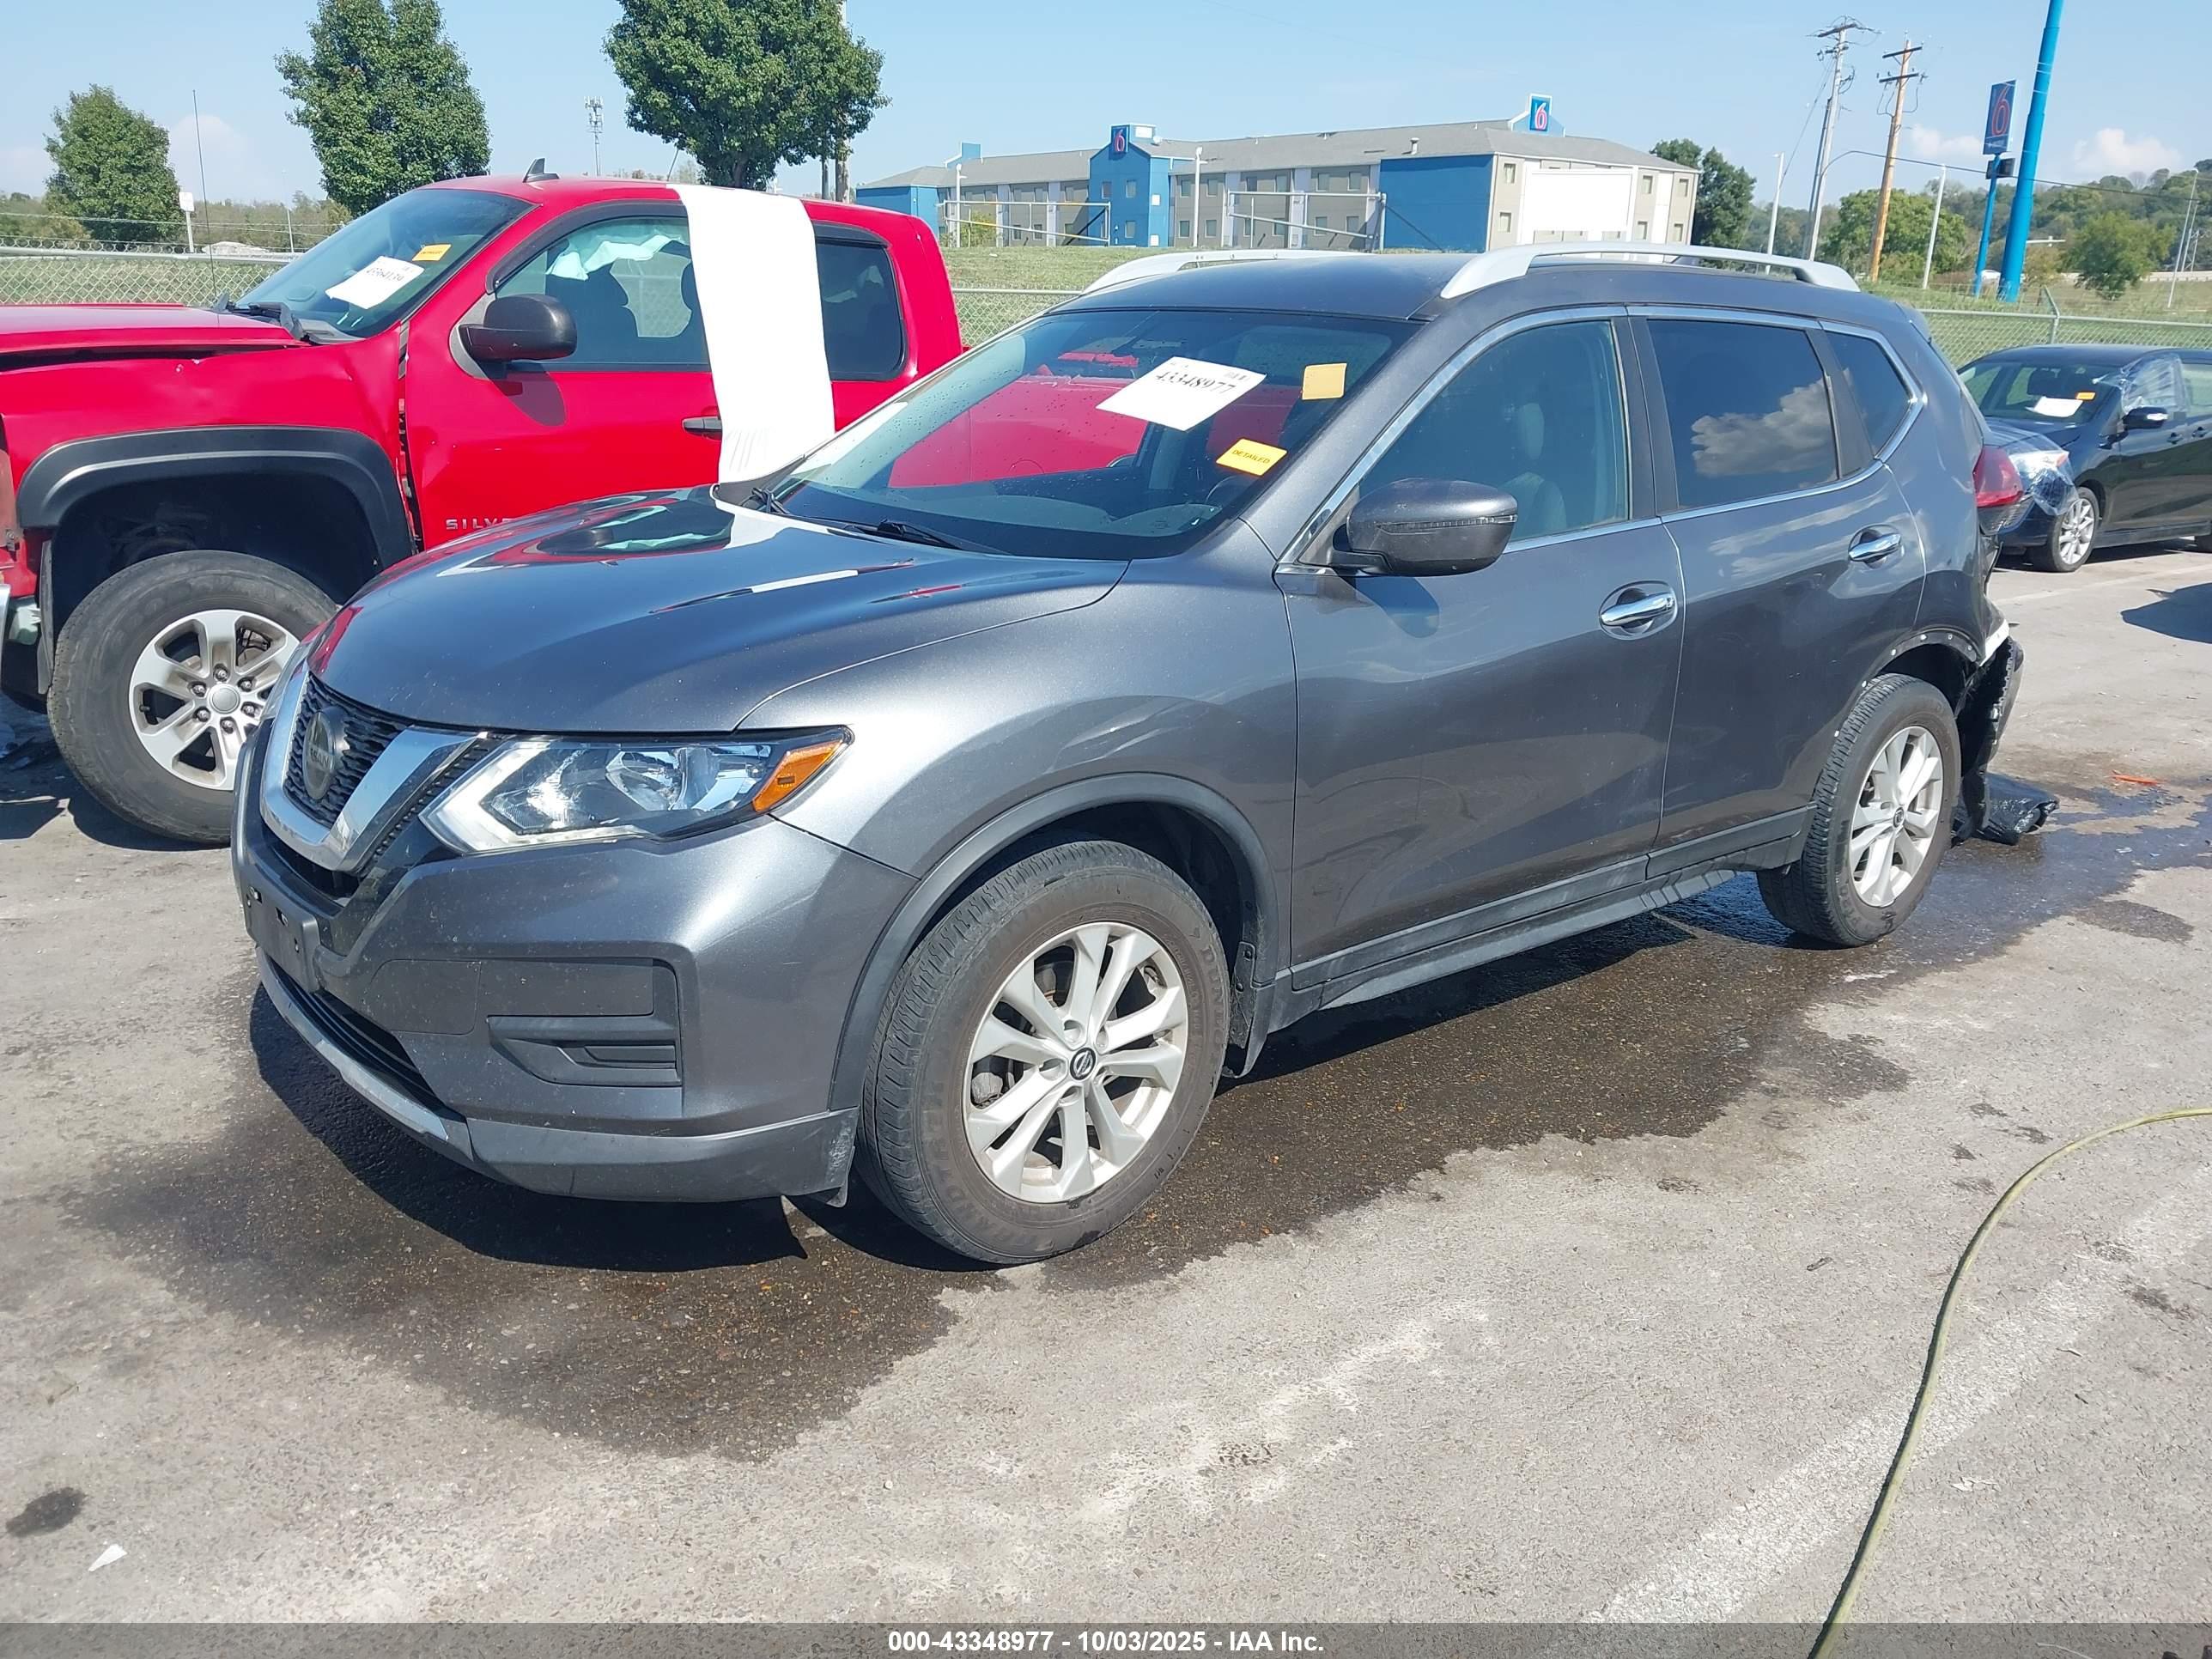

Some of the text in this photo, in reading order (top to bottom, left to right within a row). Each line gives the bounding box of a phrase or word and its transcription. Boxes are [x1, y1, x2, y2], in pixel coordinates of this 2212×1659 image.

[1534, 102, 1547, 130] 6
[1992, 84, 2010, 136] 6
[1115, 129, 1125, 152] 6
[1157, 371, 1237, 393] 43348977
[1231, 449, 1270, 465] DETAILED
